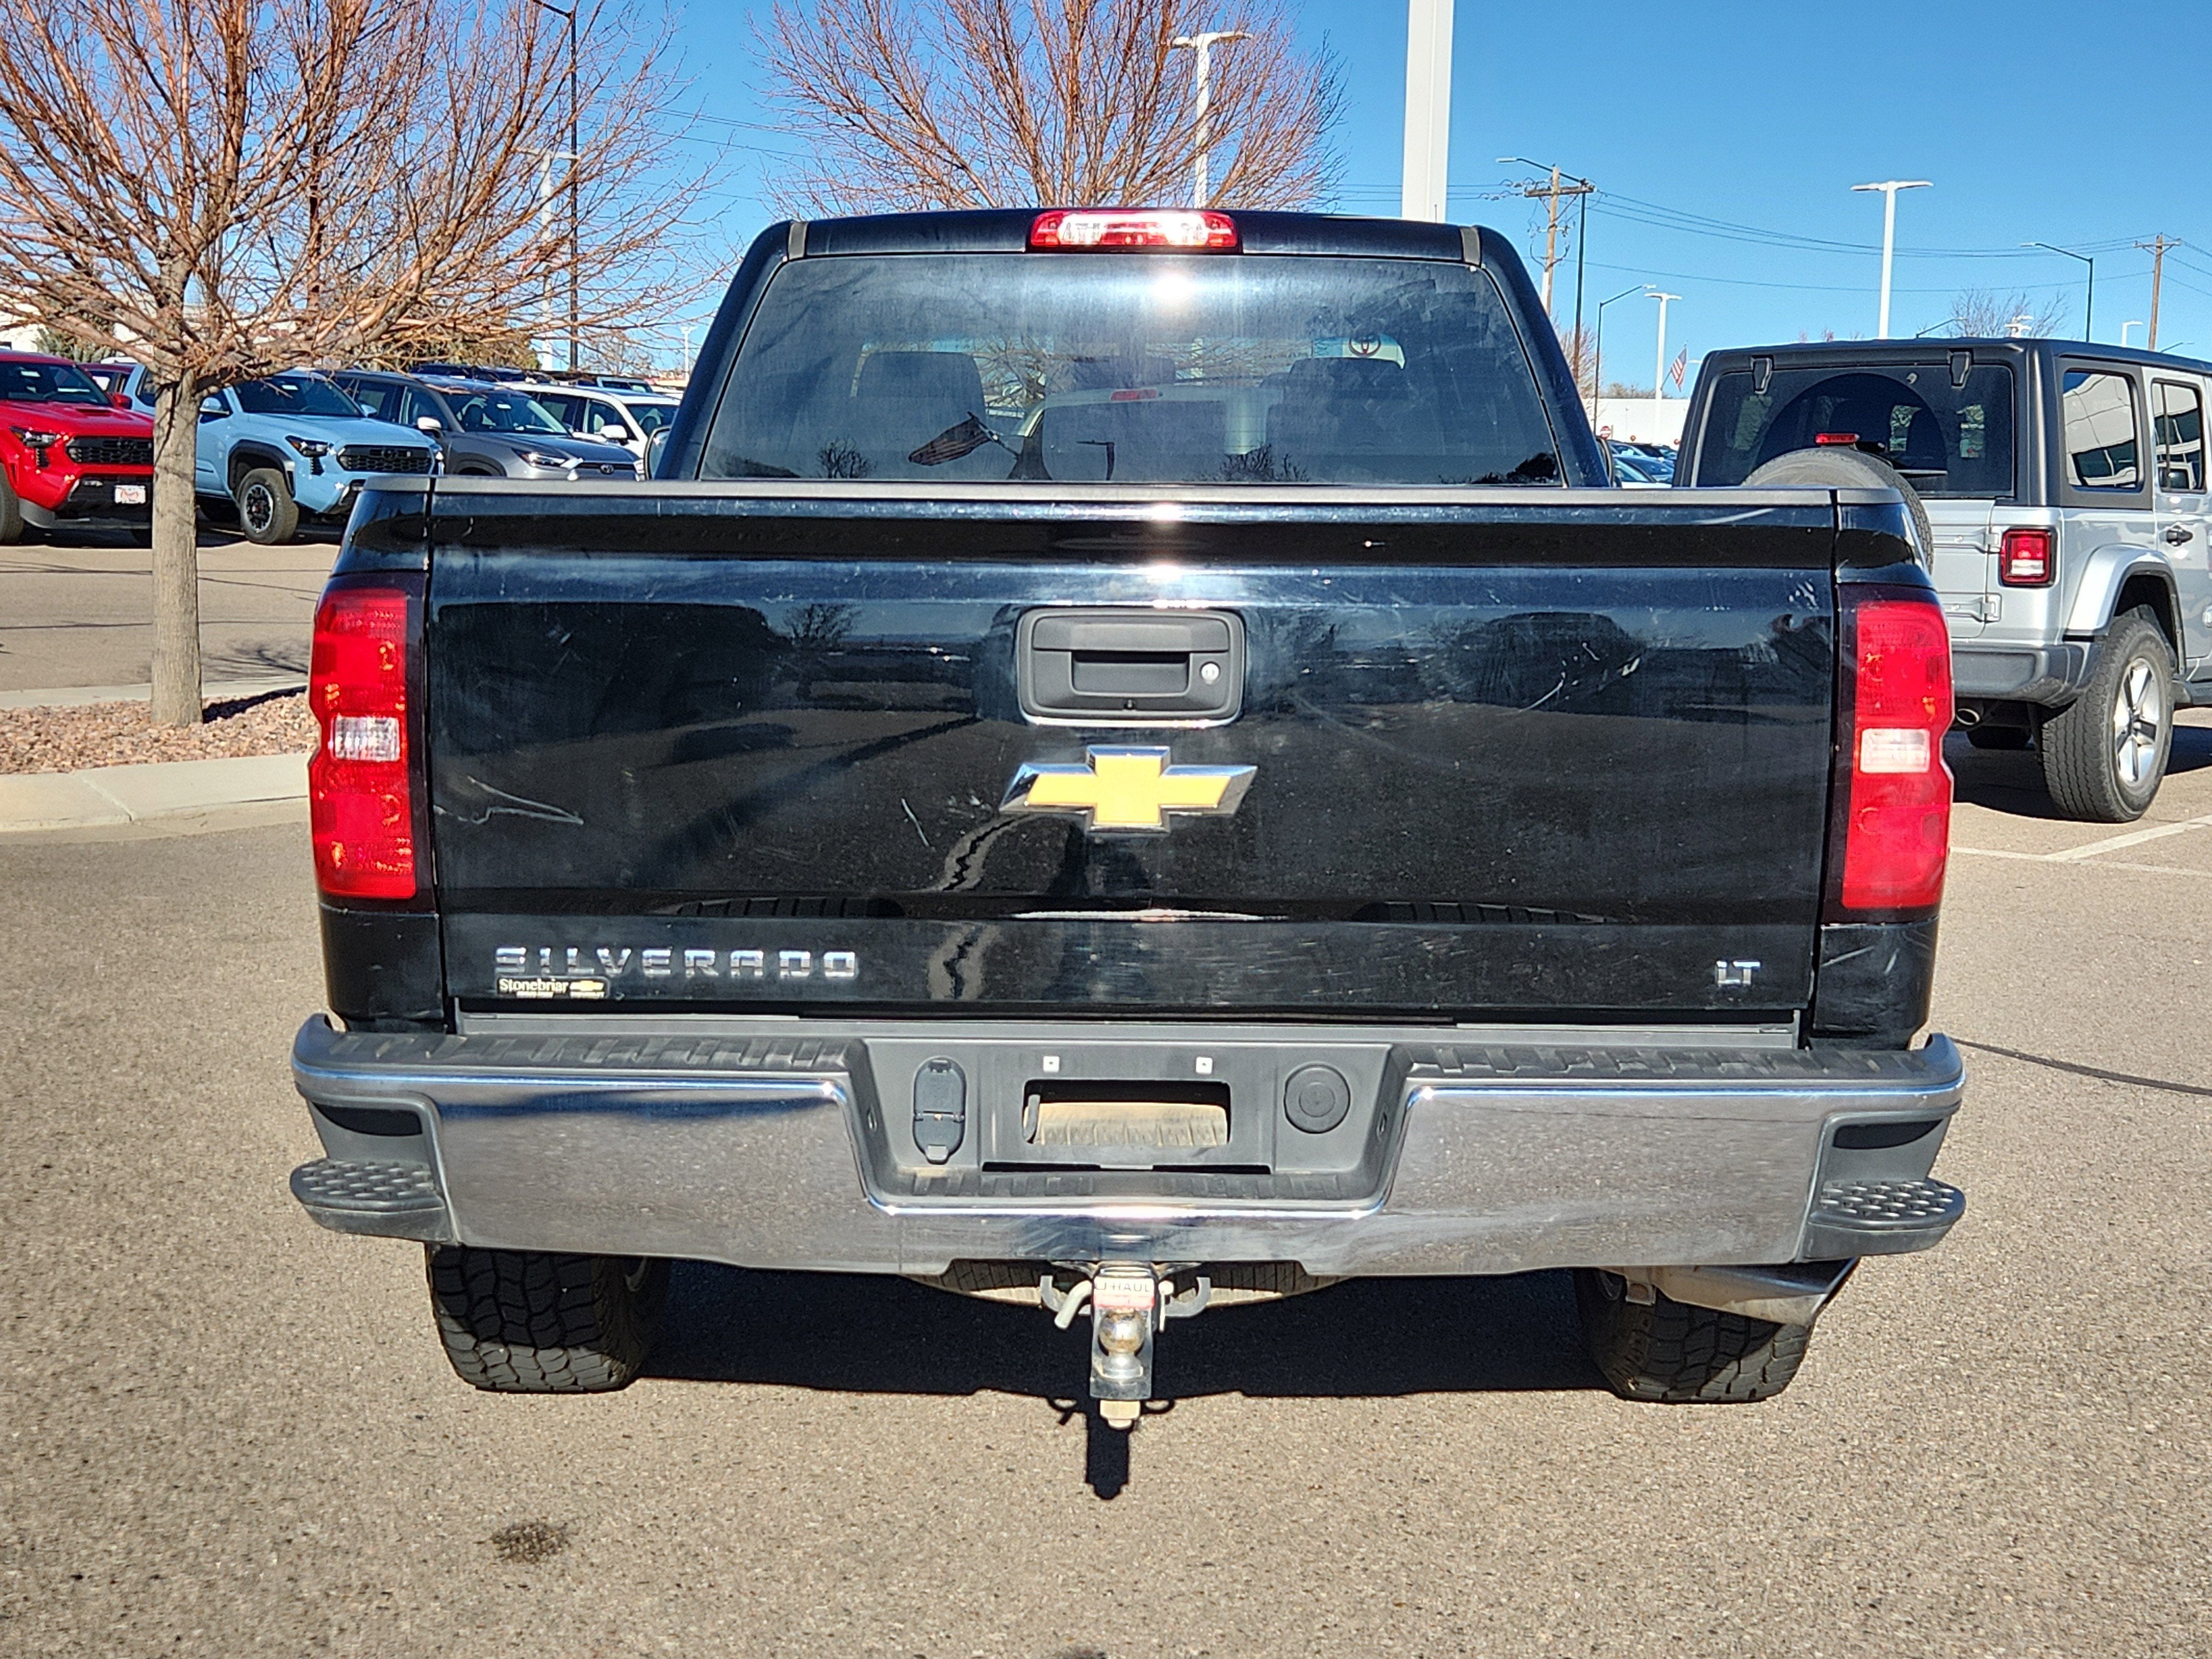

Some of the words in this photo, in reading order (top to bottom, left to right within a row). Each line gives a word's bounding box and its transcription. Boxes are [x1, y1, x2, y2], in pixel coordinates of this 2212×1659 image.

[494, 946, 856, 978] SILVERADO
[1715, 960, 1761, 987] LT
[498, 978, 569, 994] Stonebriar
